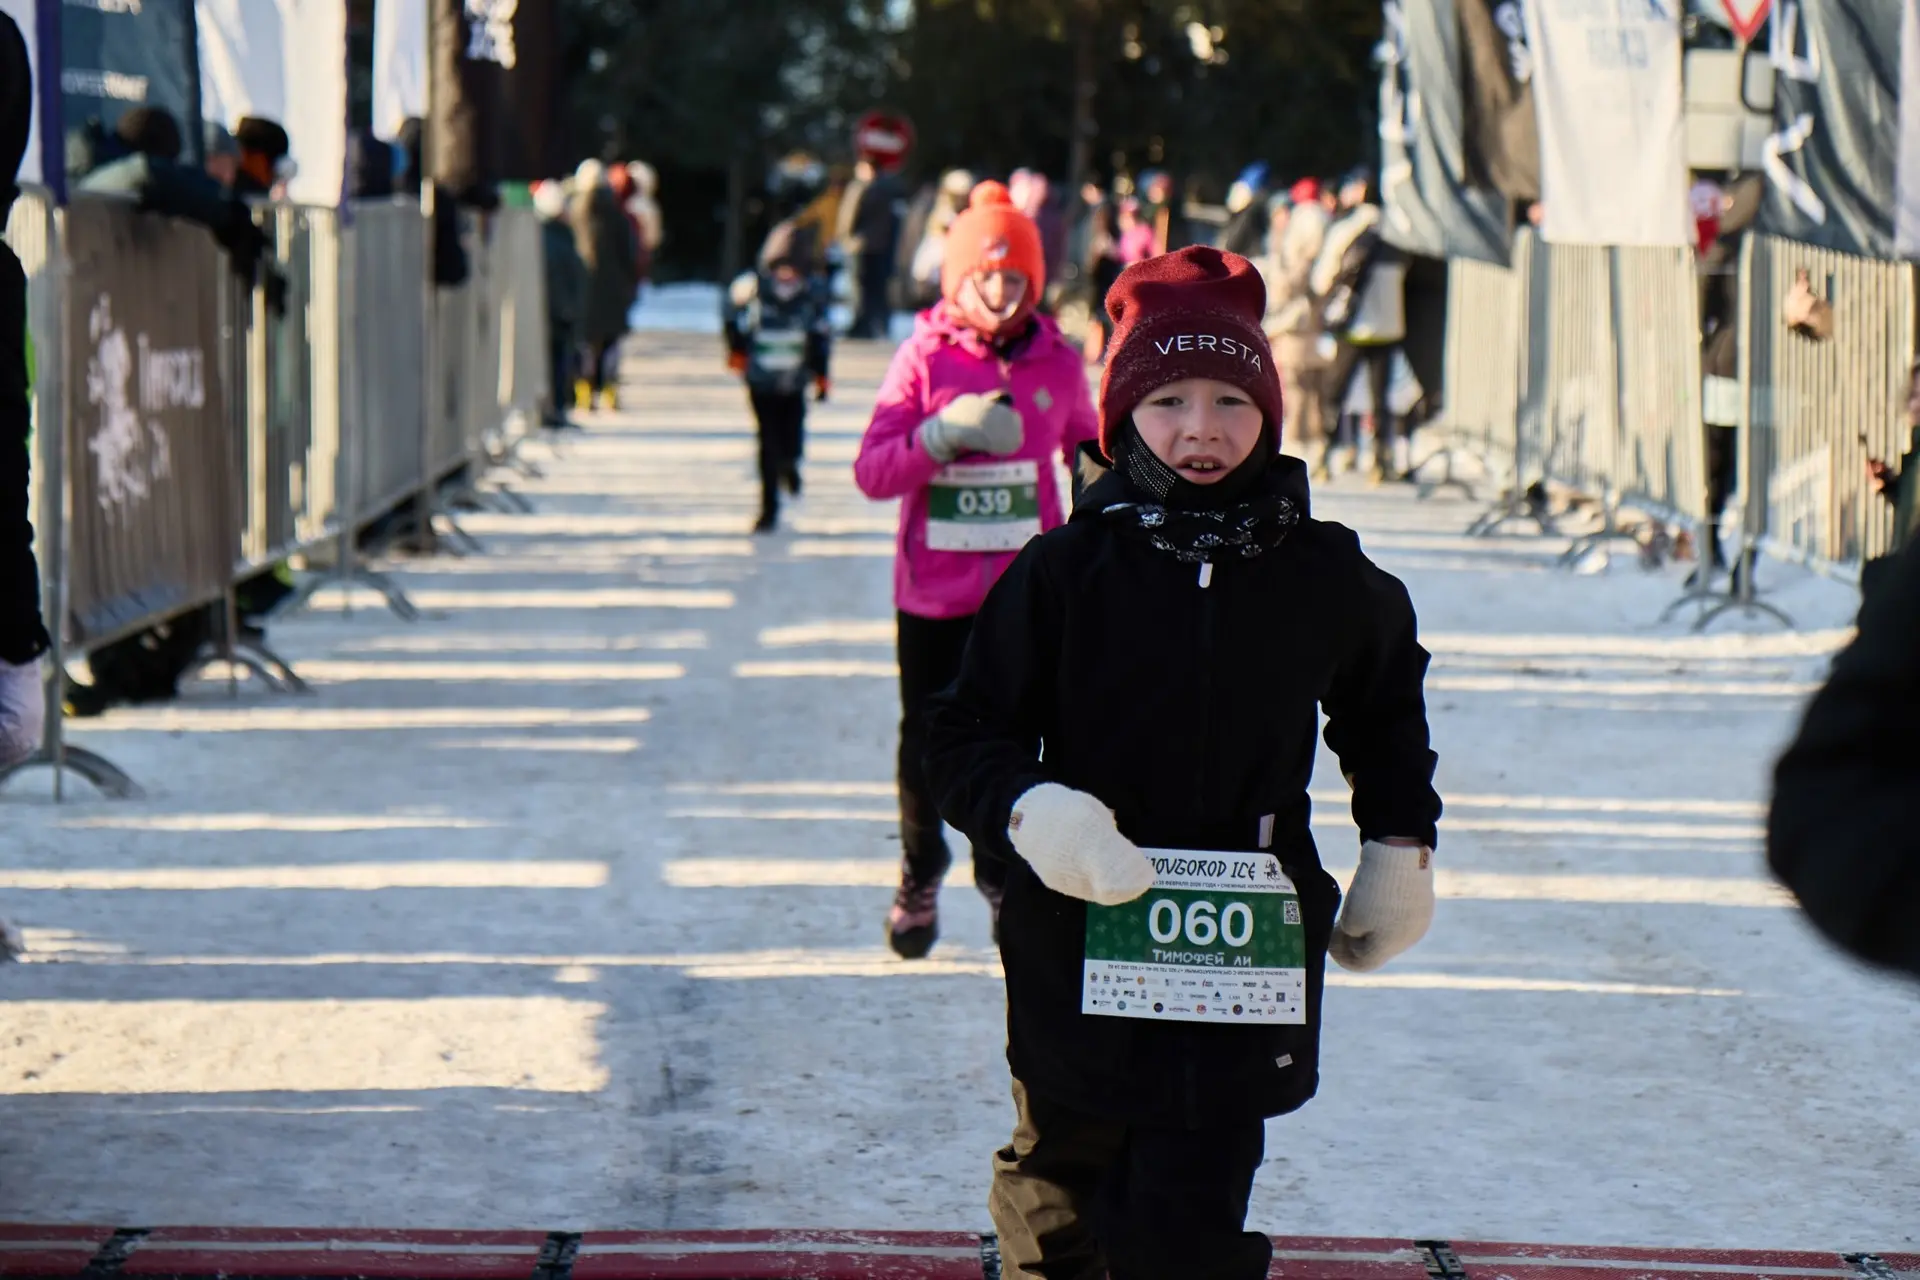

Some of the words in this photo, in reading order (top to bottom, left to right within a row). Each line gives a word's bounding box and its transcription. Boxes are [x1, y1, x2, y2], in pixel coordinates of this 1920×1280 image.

[1155, 334, 1262, 373] VERSTA
[957, 488, 1012, 514] 039
[1230, 861, 1256, 881] ICE
[1149, 898, 1254, 948] 060
[1152, 948, 1225, 967] ТИМОФЕЙ
[1233, 955, 1252, 967] ЛИ
